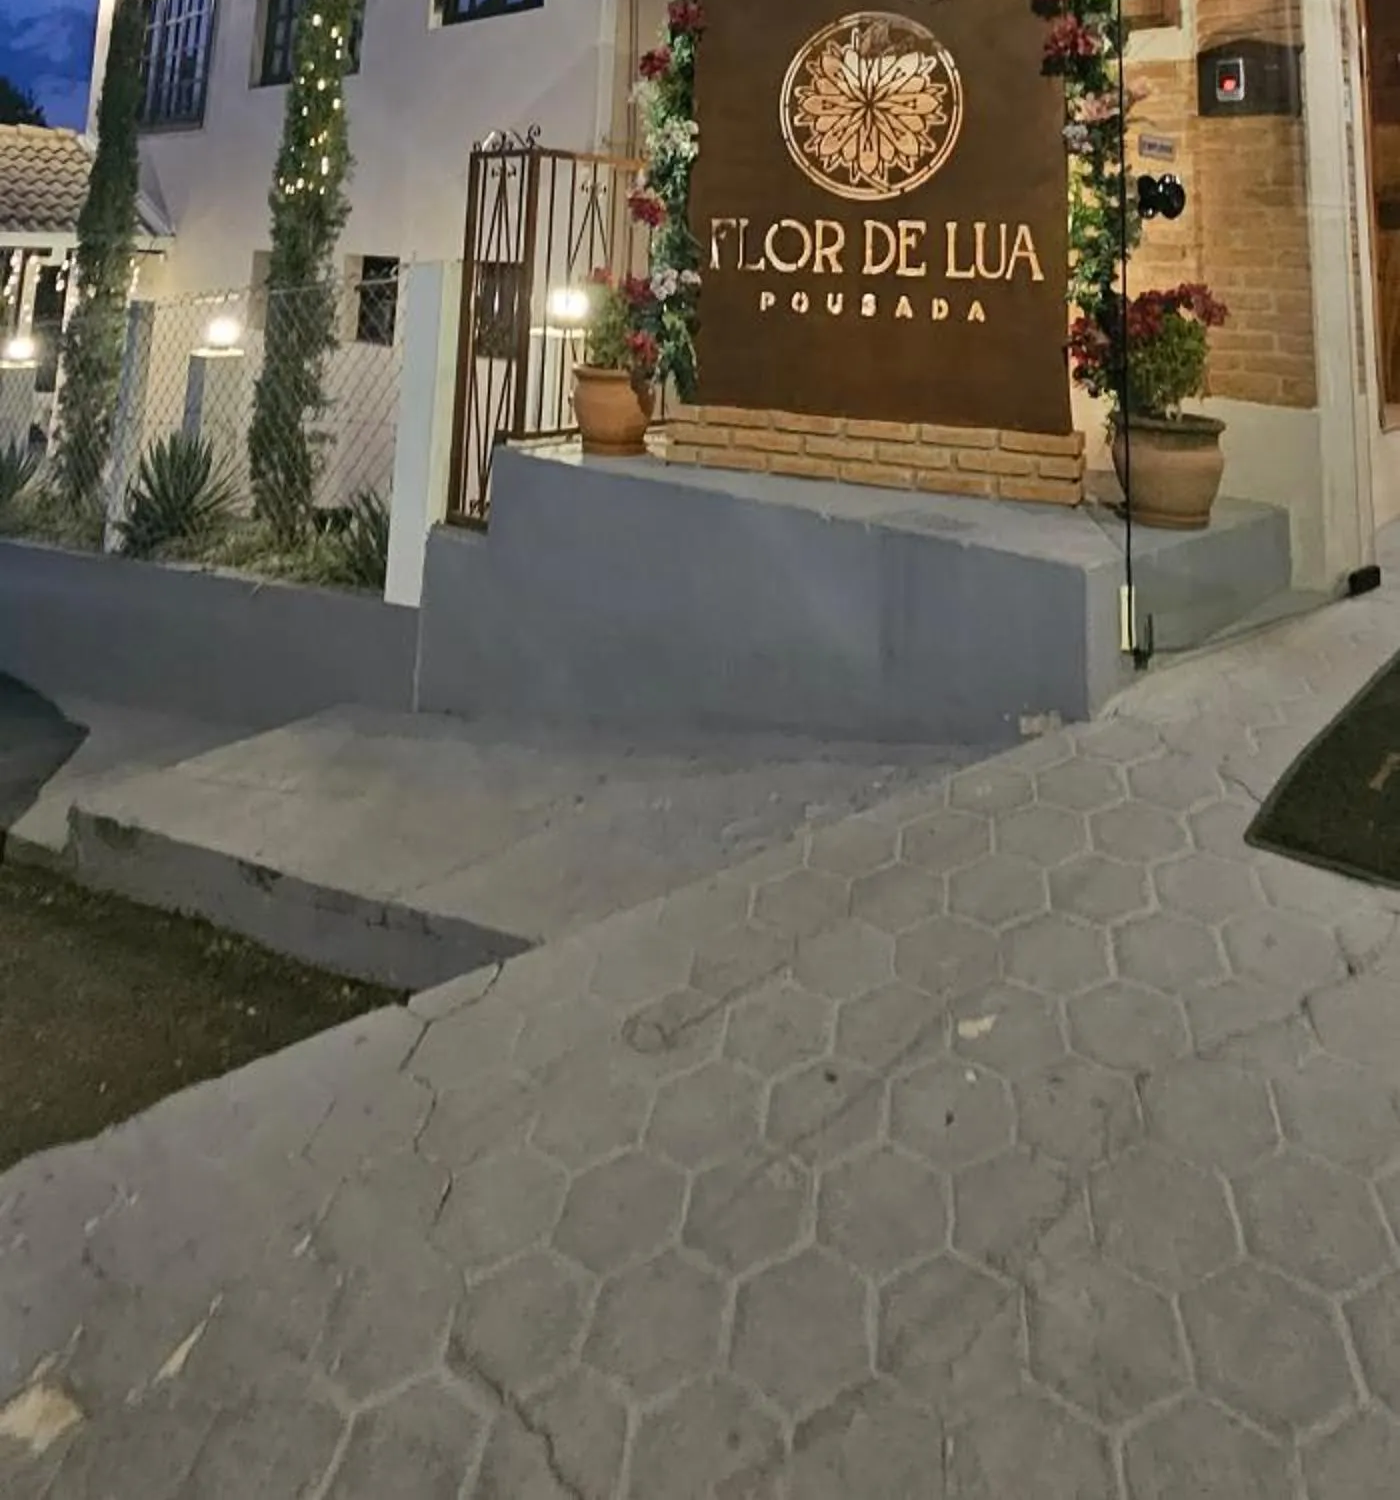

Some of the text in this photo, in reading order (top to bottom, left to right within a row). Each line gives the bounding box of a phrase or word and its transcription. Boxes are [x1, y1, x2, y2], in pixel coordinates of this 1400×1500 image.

[708, 218, 1045, 281] FLOR DE LUA
[759, 291, 986, 322] POUSADA
